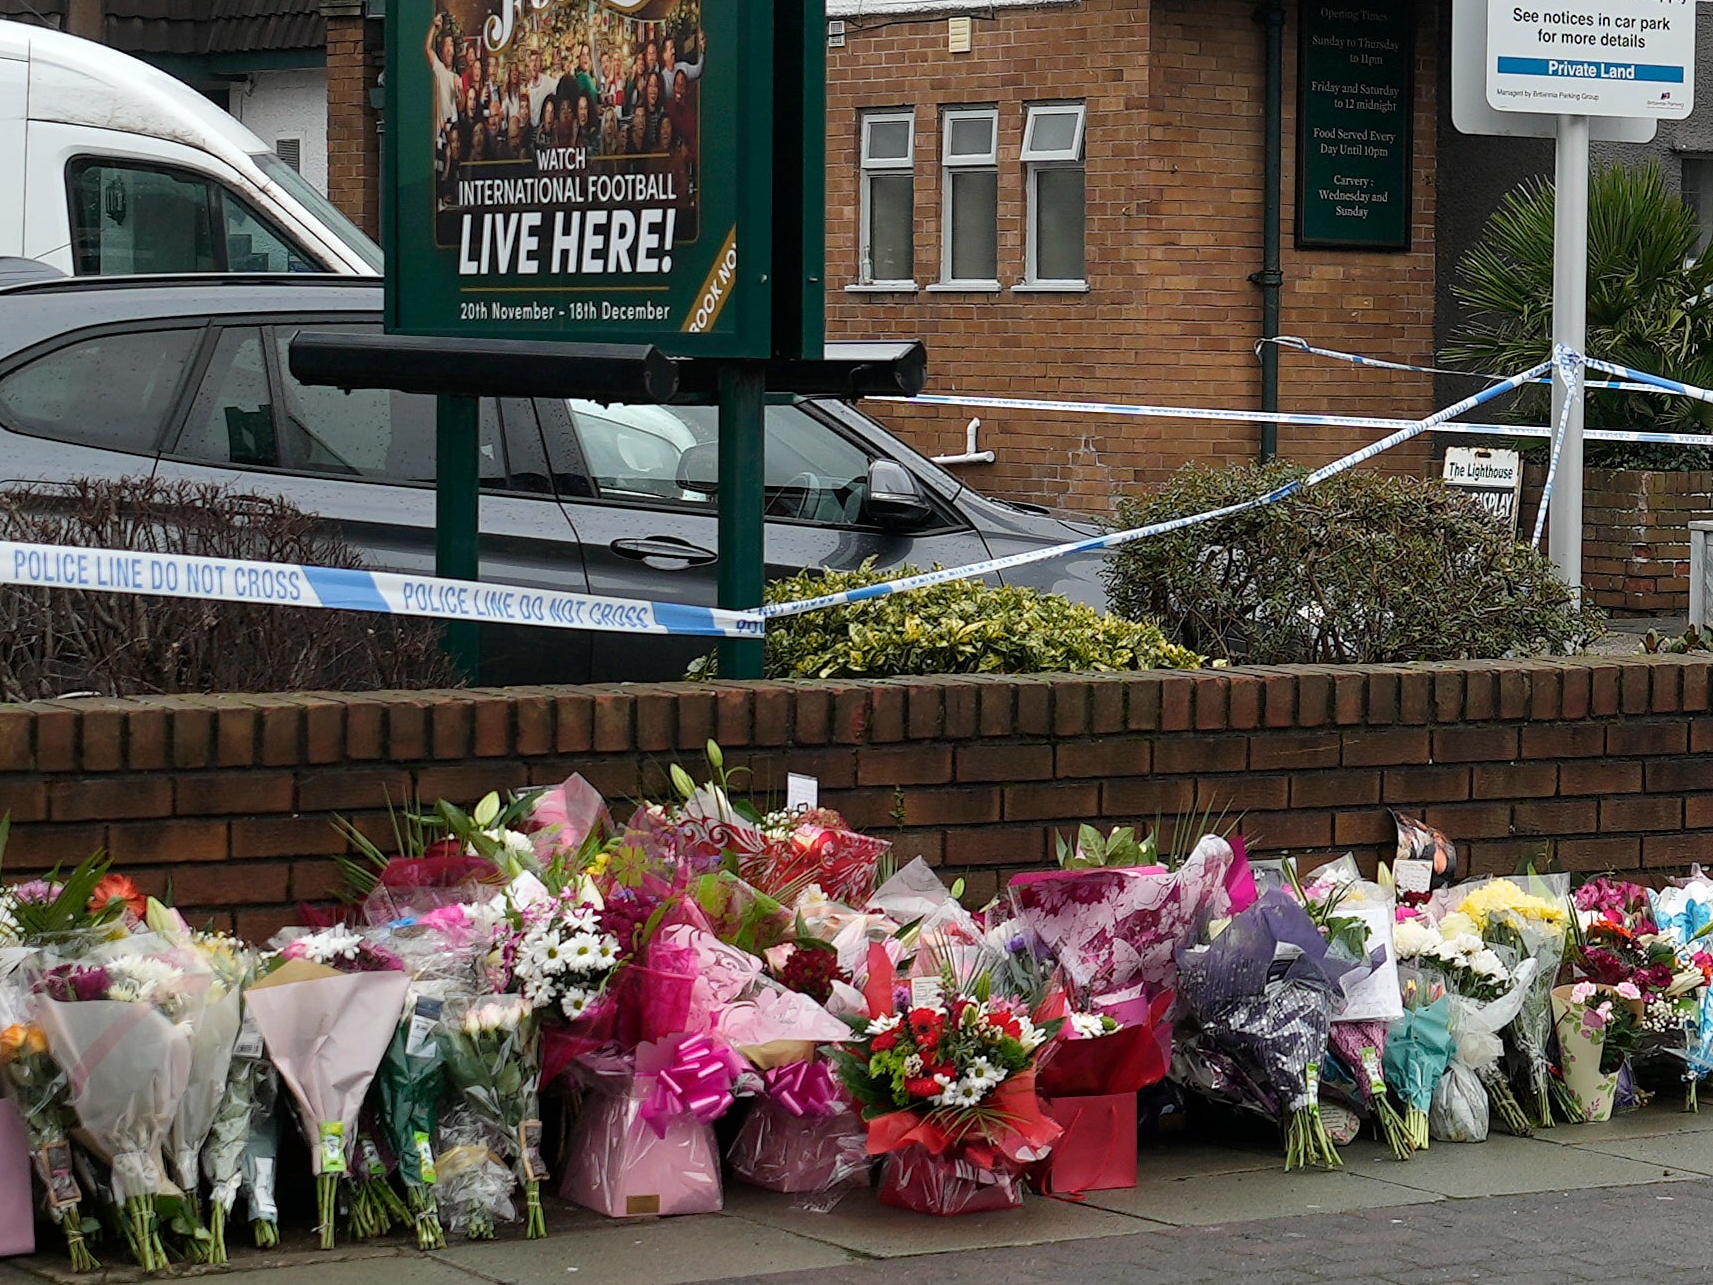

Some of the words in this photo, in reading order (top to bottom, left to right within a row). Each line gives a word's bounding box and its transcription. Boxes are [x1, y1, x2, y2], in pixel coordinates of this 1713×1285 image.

[1320, 6, 1360, 22] Opening
[1360, 10, 1389, 22] Times
[1512, 7, 1539, 24] See
[1543, 9, 1595, 28] notices
[1598, 12, 1611, 27] in
[1614, 16, 1637, 30] car
[1640, 15, 1671, 33] park
[1311, 34, 1345, 49] Sunday
[1346, 37, 1356, 48] to
[1357, 37, 1400, 53] Thursday
[1537, 28, 1558, 44] for
[1560, 33, 1598, 47] more
[1600, 32, 1646, 49] details
[1349, 53, 1359, 64] to
[1547, 60, 1597, 78] Private
[1600, 63, 1635, 80] Land
[1311, 80, 1340, 96] Friday
[1341, 83, 1358, 95] and
[1359, 83, 1400, 99] Saturday
[1334, 99, 1343, 109] to
[1344, 99, 1355, 110] 12
[1355, 99, 1397, 114] midnight
[1313, 127, 1336, 140] Food
[1337, 128, 1369, 142] Served
[1370, 130, 1396, 145] Every
[537, 146, 587, 172] WATCH
[1320, 144, 1338, 157] Day
[1339, 143, 1363, 157] Until
[1364, 145, 1388, 158] 10pm
[458, 175, 585, 206] INTERNATIONAL
[588, 173, 677, 203] FOOTBALL
[1333, 174, 1369, 189] Carvery
[1318, 190, 1370, 204] Wednesday
[1371, 191, 1388, 203] and
[1335, 205, 1369, 220] Sunday
[459, 211, 543, 276] LIVE
[552, 208, 676, 275] HERE!
[459, 301, 489, 321] 20th
[491, 300, 556, 322] November
[569, 301, 598, 321] 18th
[601, 300, 670, 321] December
[1449, 462, 1465, 477] The
[1467, 463, 1514, 481] Lighthouse
[13, 548, 90, 588] POLICE
[97, 555, 143, 590] LINE
[148, 559, 178, 592] DO
[186, 561, 227, 597] NOT
[234, 564, 301, 602] CROSS
[402, 580, 468, 615] POLICE
[474, 589, 514, 619] LINE
[519, 594, 548, 623] DO
[554, 598, 584, 626] NOT
[589, 601, 650, 629] CROSS
